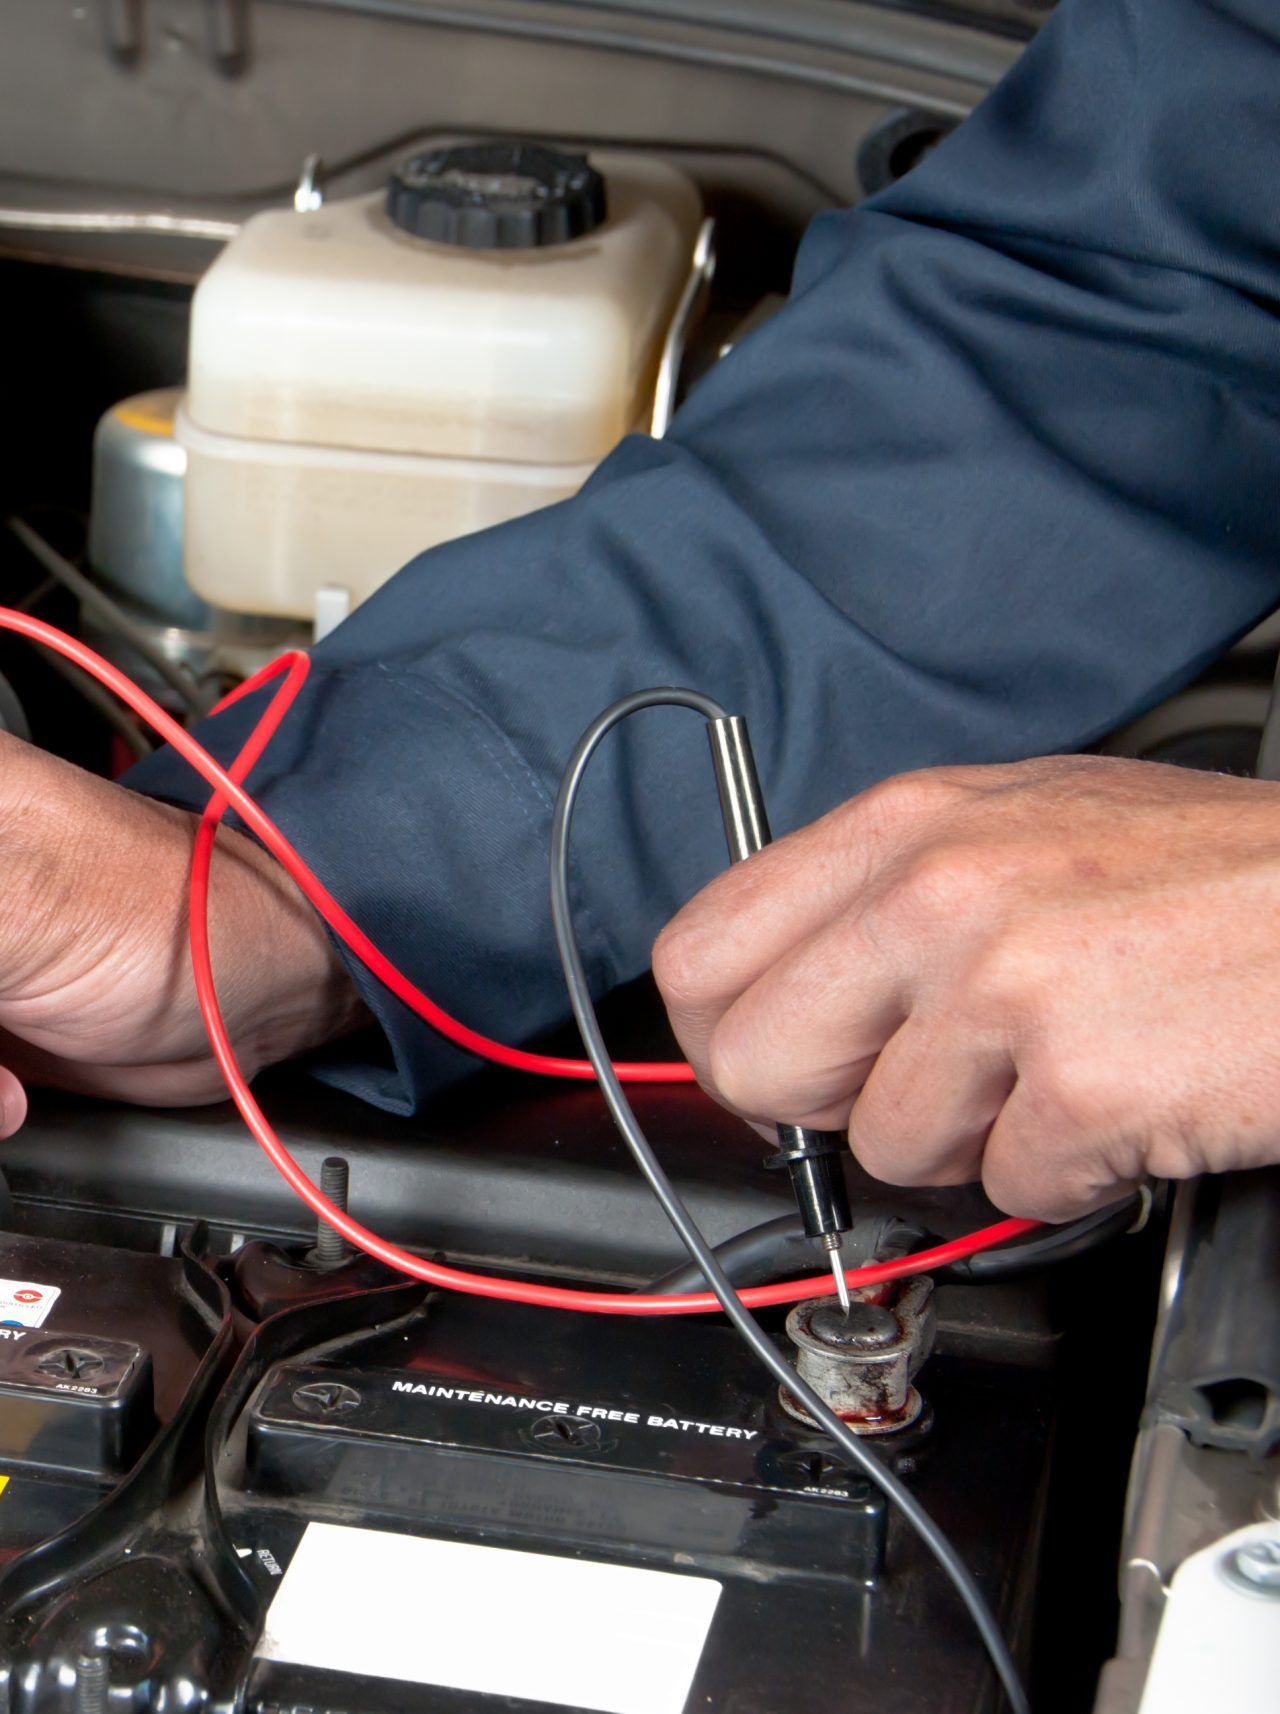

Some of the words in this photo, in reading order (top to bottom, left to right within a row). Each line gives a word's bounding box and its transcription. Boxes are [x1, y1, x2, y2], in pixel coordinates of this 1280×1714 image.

[391, 1380, 571, 1415] MAINTENANCE
[575, 1404, 641, 1425] FREE
[646, 1414, 760, 1441] BATTERY
